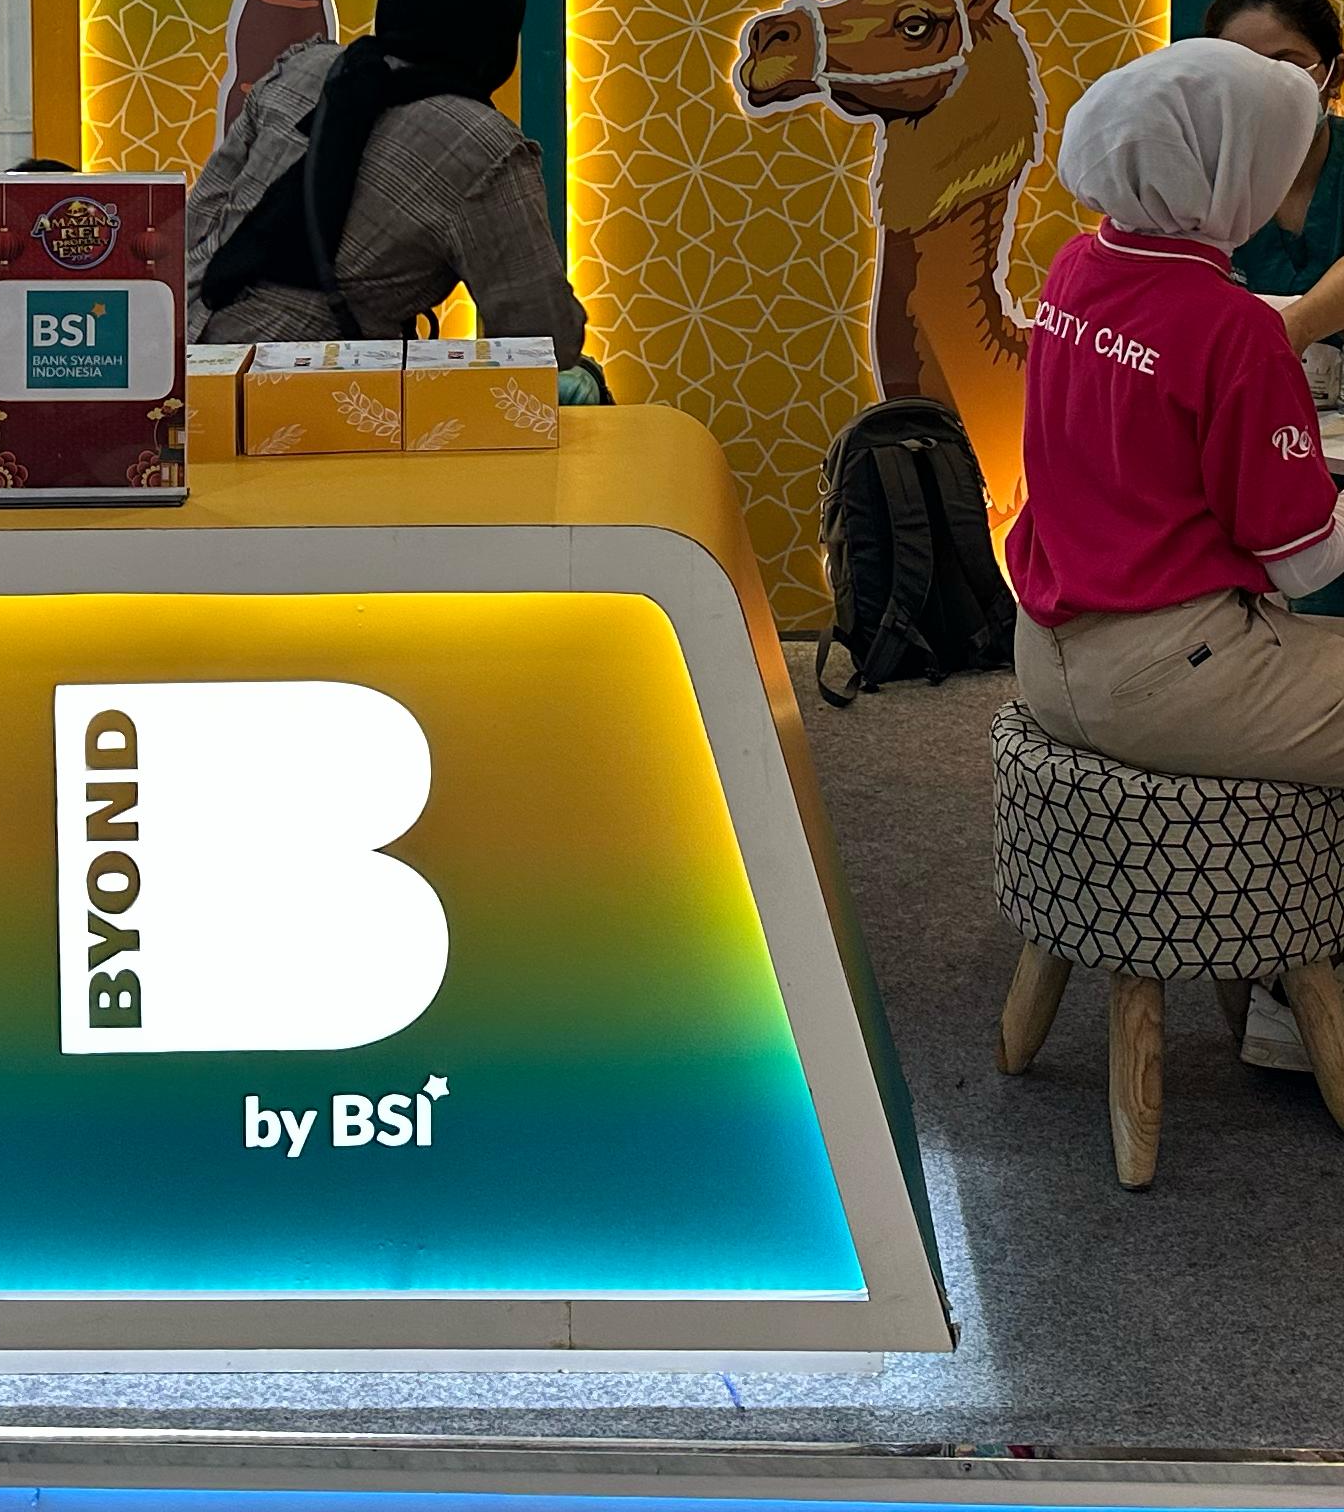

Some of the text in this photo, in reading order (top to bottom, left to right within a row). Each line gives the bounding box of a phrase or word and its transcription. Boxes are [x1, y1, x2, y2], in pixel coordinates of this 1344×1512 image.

[32, 314, 96, 347] BSI
[32, 355, 123, 366] BANK SYARIAH
[1094, 327, 1161, 376] CARE
[32, 367, 102, 378] INDONESIA
[85, 709, 142, 1029] BYOND
[245, 1093, 433, 1158] by BSI
